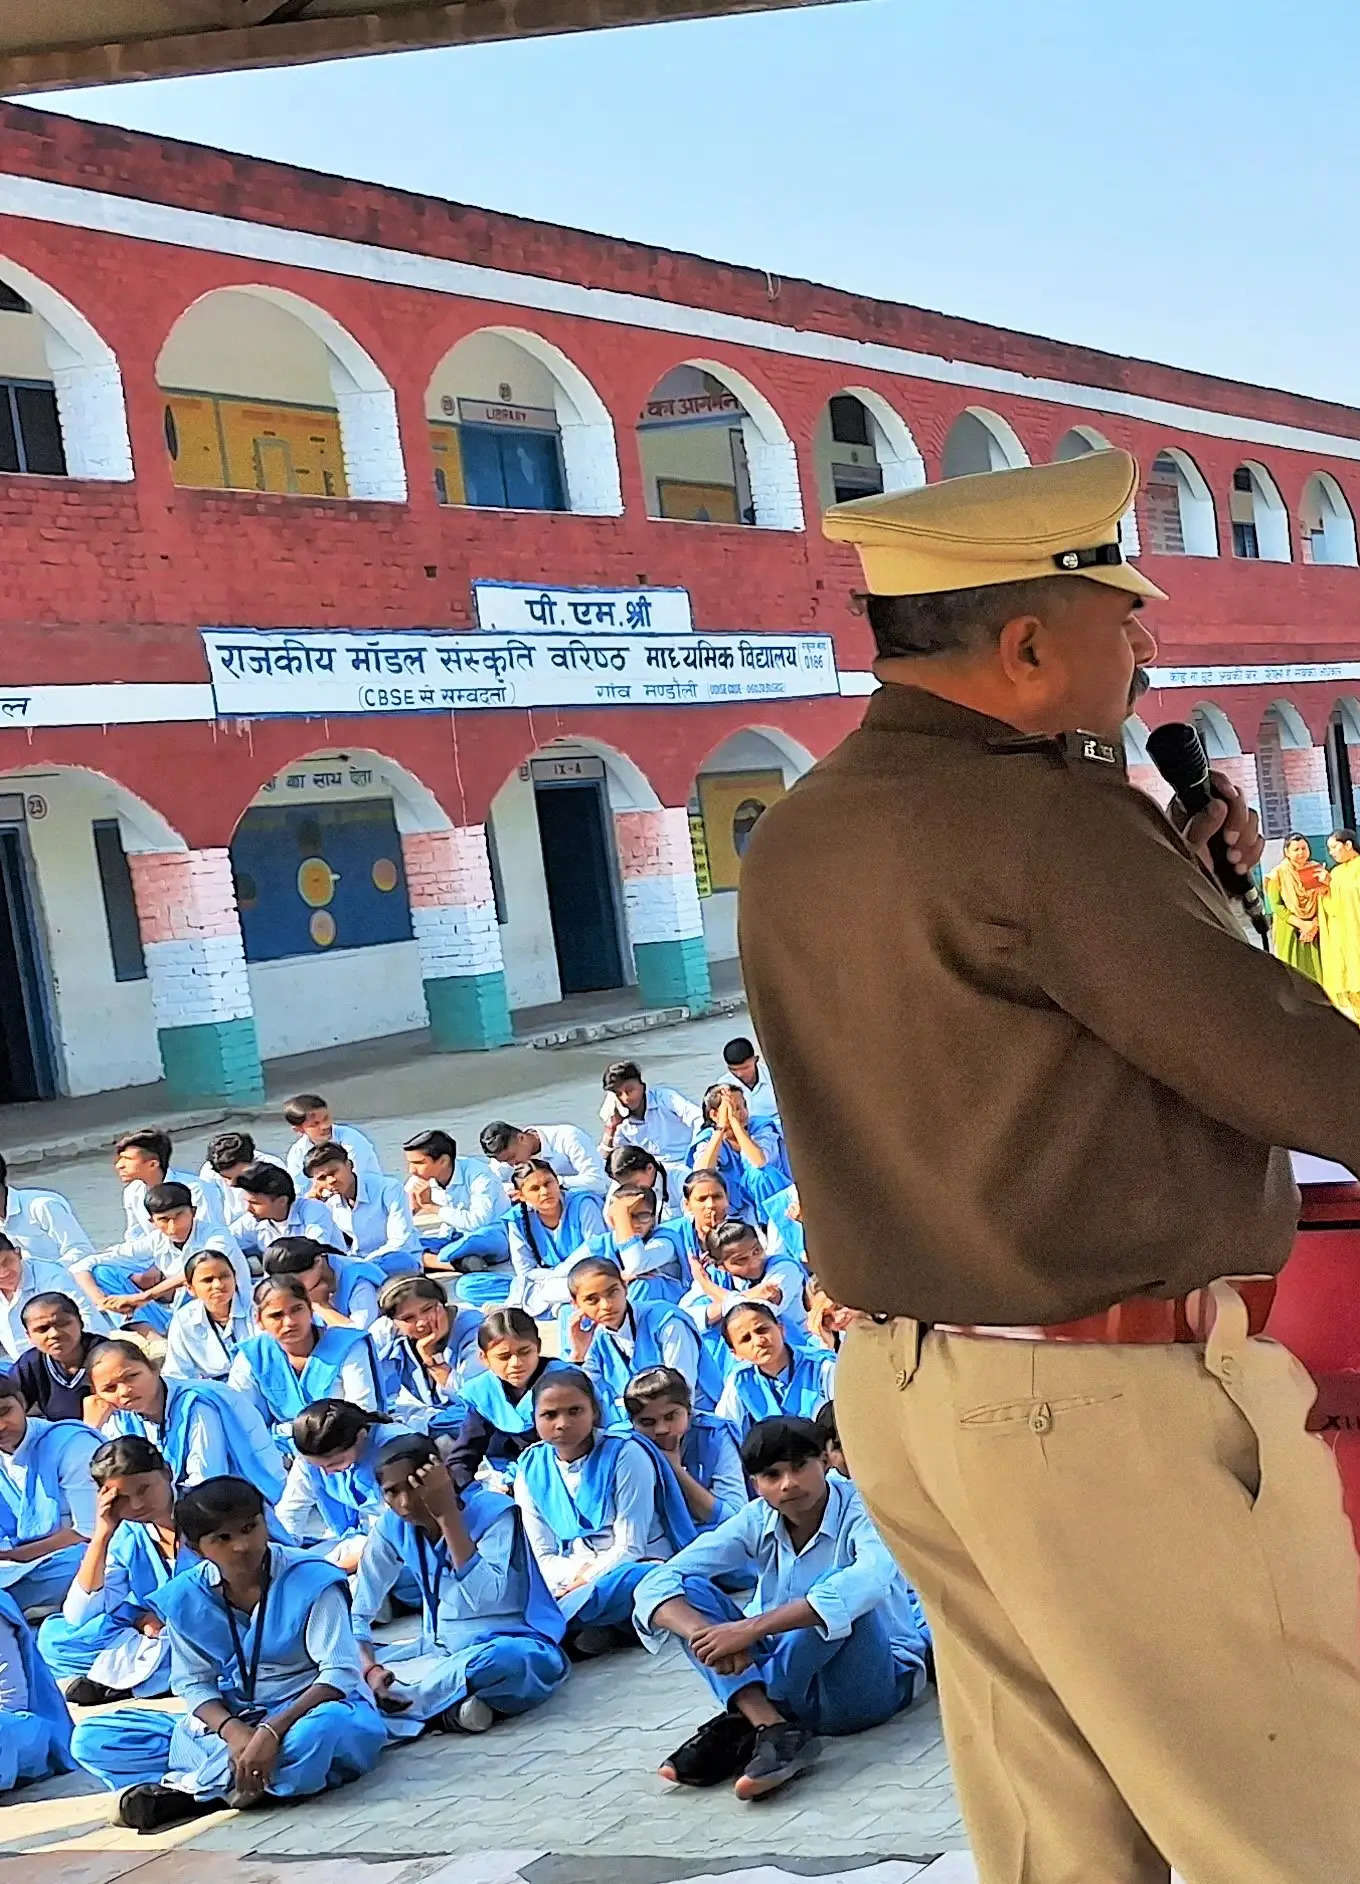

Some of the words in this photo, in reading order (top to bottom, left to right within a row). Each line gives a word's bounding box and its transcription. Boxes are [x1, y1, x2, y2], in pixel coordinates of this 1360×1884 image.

[486, 408, 527, 422] LIBRARY
[215, 639, 337, 679] राजकीय
[346, 641, 427, 674] मॉडल
[436, 640, 536, 682] संस्कृति
[547, 639, 630, 671] वरिष्ठ
[644, 640, 734, 670] माध्यमिक
[738, 640, 798, 670] विद्यालय
[359, 686, 414, 710] (CBSE
[595, 684, 630, 700] गांव
